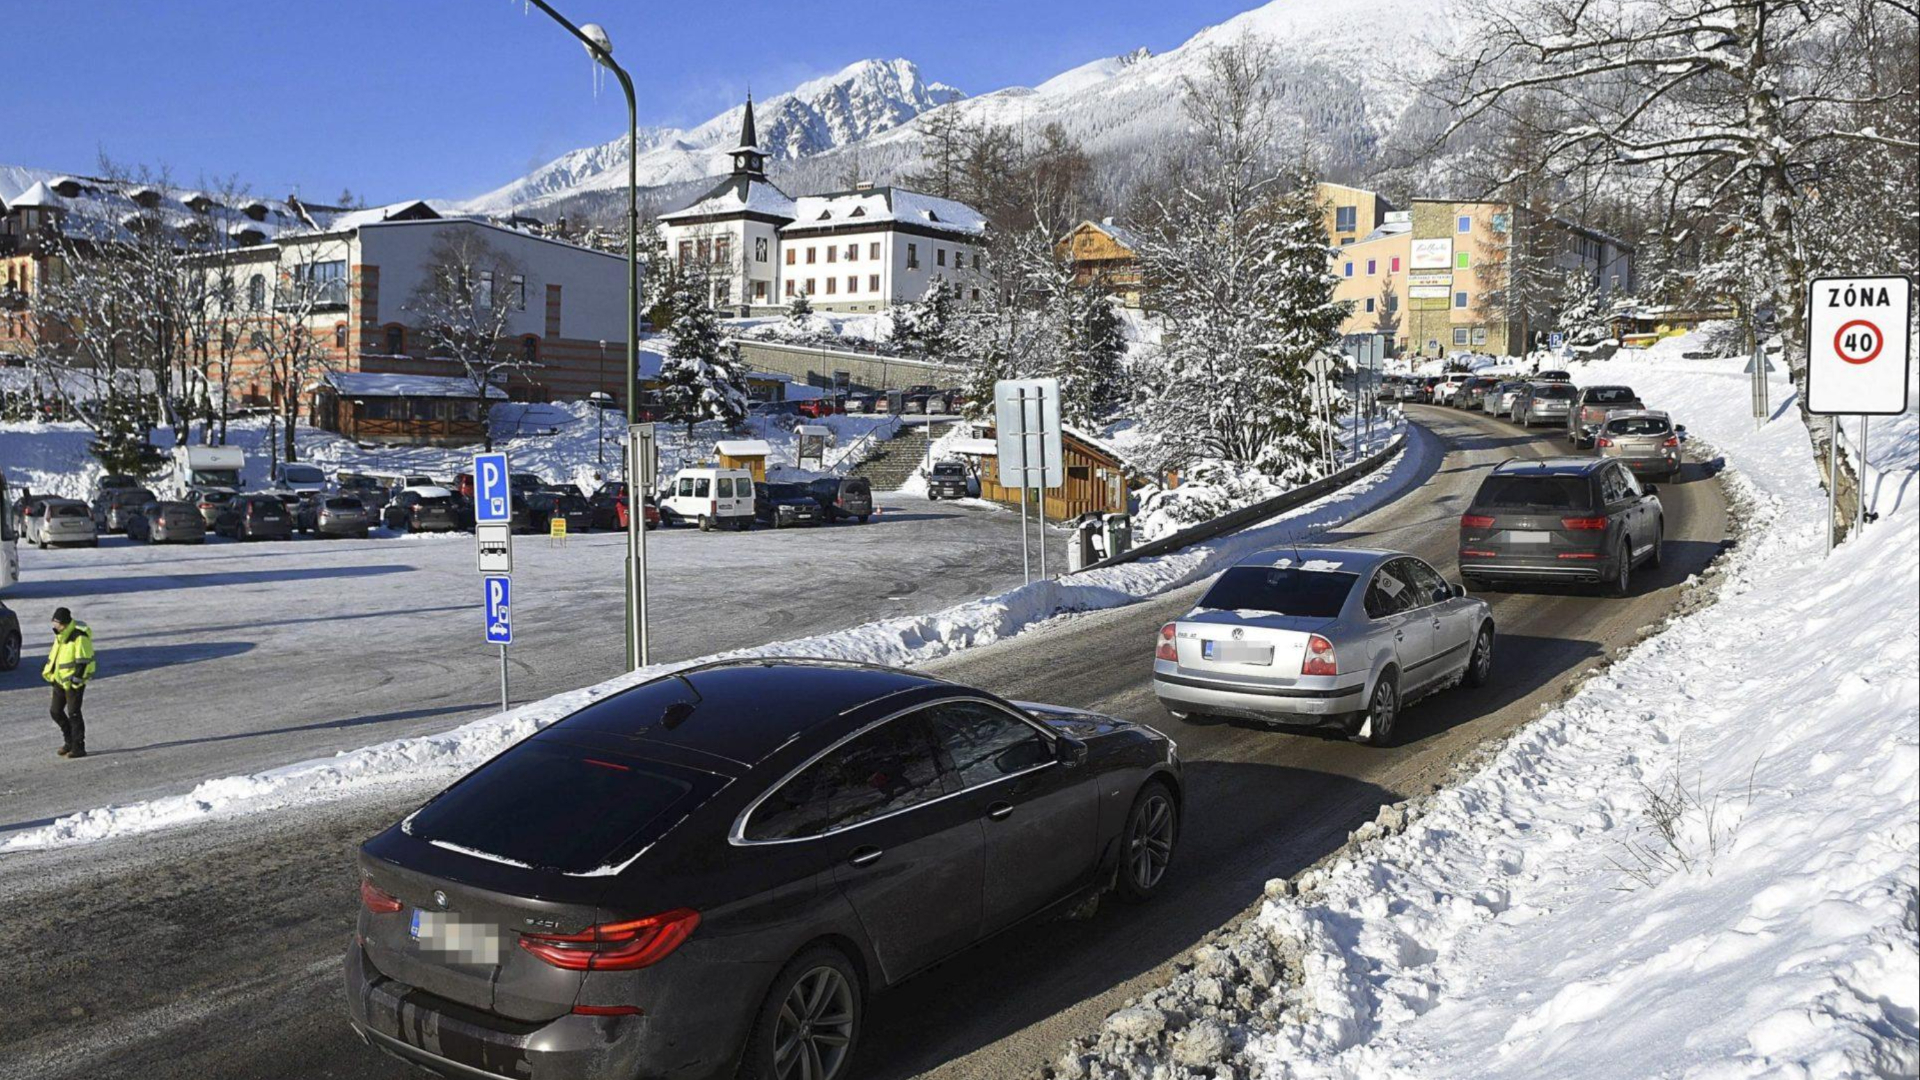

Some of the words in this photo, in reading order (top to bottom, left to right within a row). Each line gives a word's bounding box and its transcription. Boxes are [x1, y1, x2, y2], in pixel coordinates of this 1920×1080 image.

[1828, 283, 1890, 307] ZÓNA
[1553, 334, 1559, 345] P
[1844, 333, 1872, 352] 40
[483, 463, 498, 499] P
[491, 580, 502, 617] P
